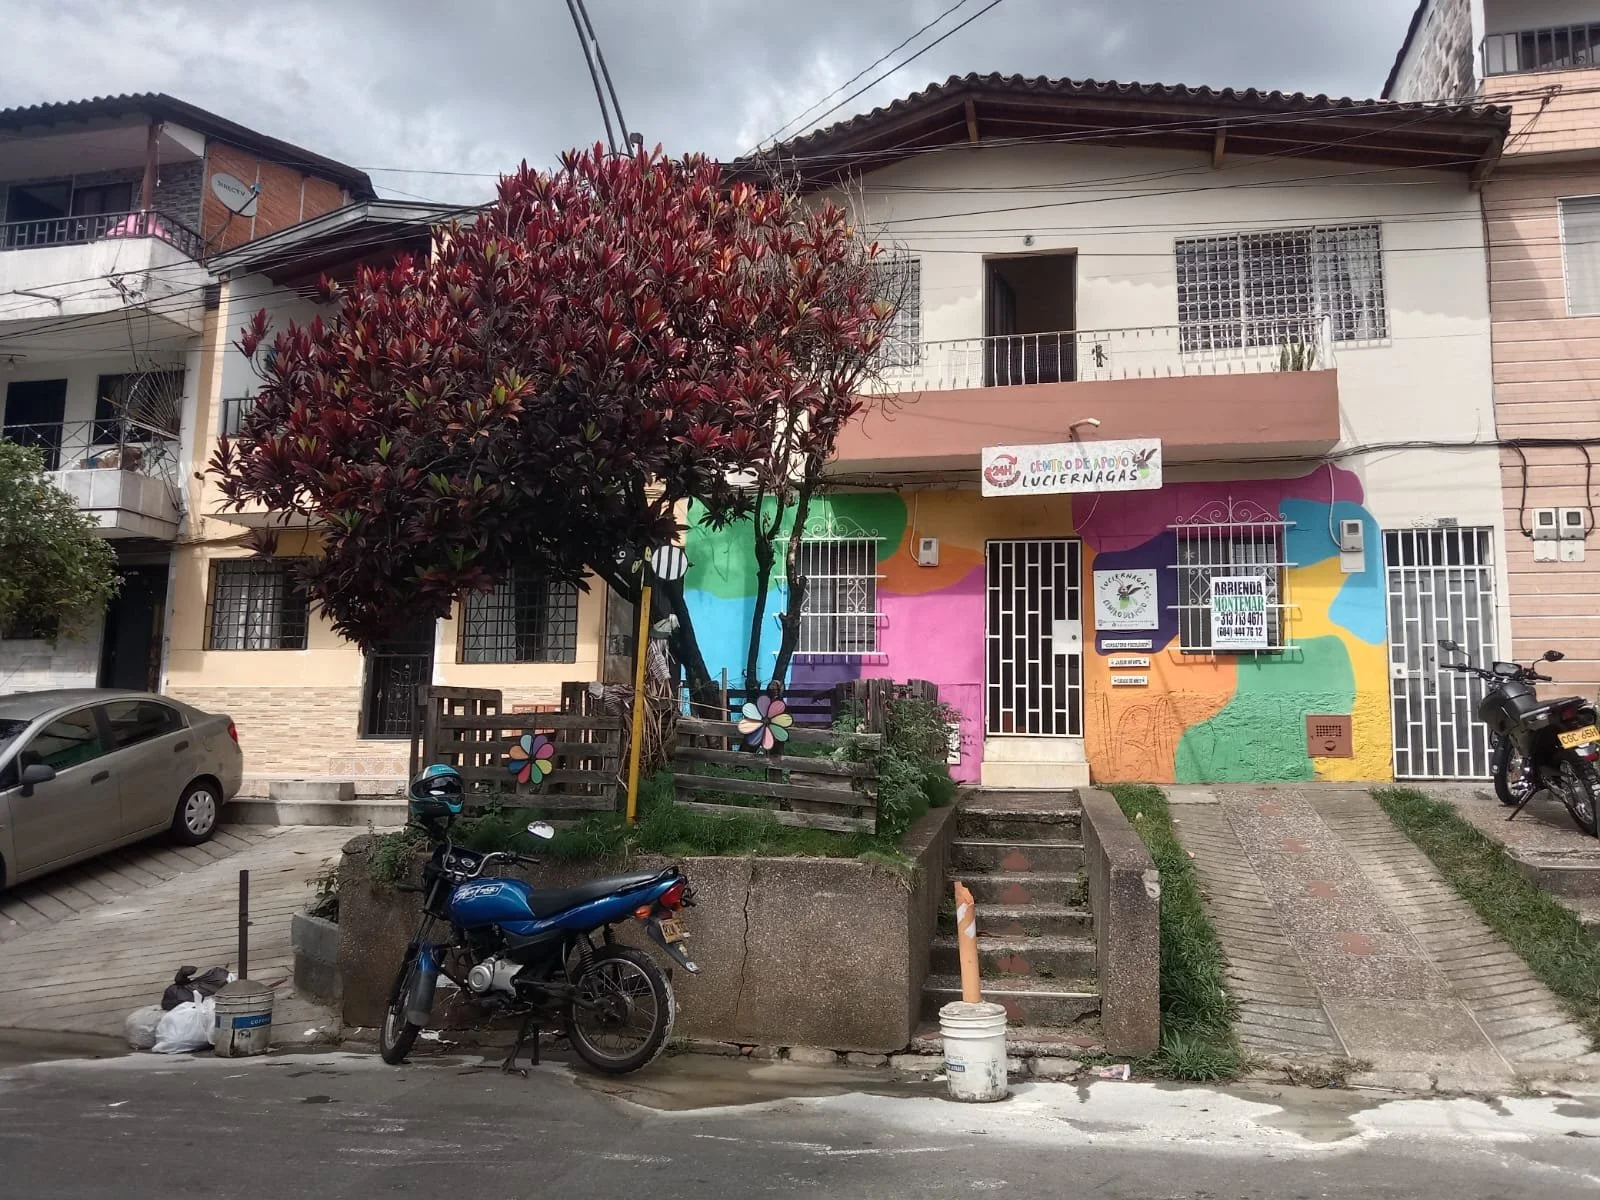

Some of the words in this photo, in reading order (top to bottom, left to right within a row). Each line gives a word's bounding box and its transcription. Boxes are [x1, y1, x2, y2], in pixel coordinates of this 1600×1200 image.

[1030, 459, 1072, 474] CENTRO
[1075, 457, 1091, 471] DE
[1093, 455, 1129, 470] APOYO
[1022, 469, 1138, 488] LUCIERNAGAS
[1214, 581, 1263, 596] ARRIENDA
[1213, 596, 1265, 612] MONTEMAR
[1220, 612, 1233, 626] 313
[1234, 612, 1246, 626] 713
[1247, 612, 1264, 626] 4671
[1561, 733, 1579, 745] CGC
